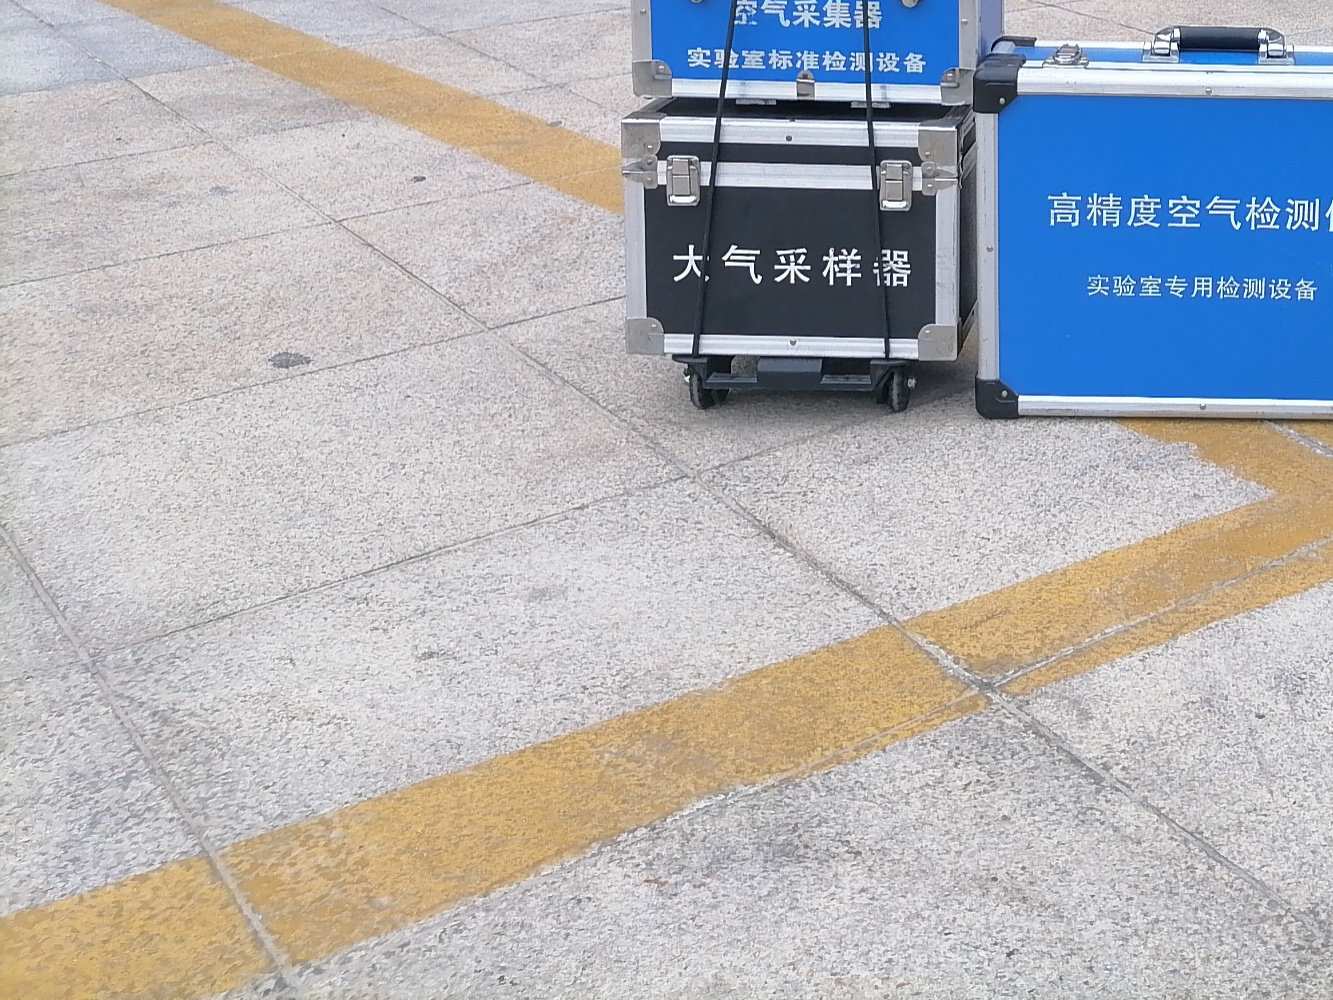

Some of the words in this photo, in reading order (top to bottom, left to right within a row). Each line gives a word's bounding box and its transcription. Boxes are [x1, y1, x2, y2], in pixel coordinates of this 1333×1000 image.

[687, 46, 927, 74] 实验室标准检测设备
[673, 244, 912, 288] 大气采样器
[1086, 273, 1319, 302] 实验室专用检测设备
